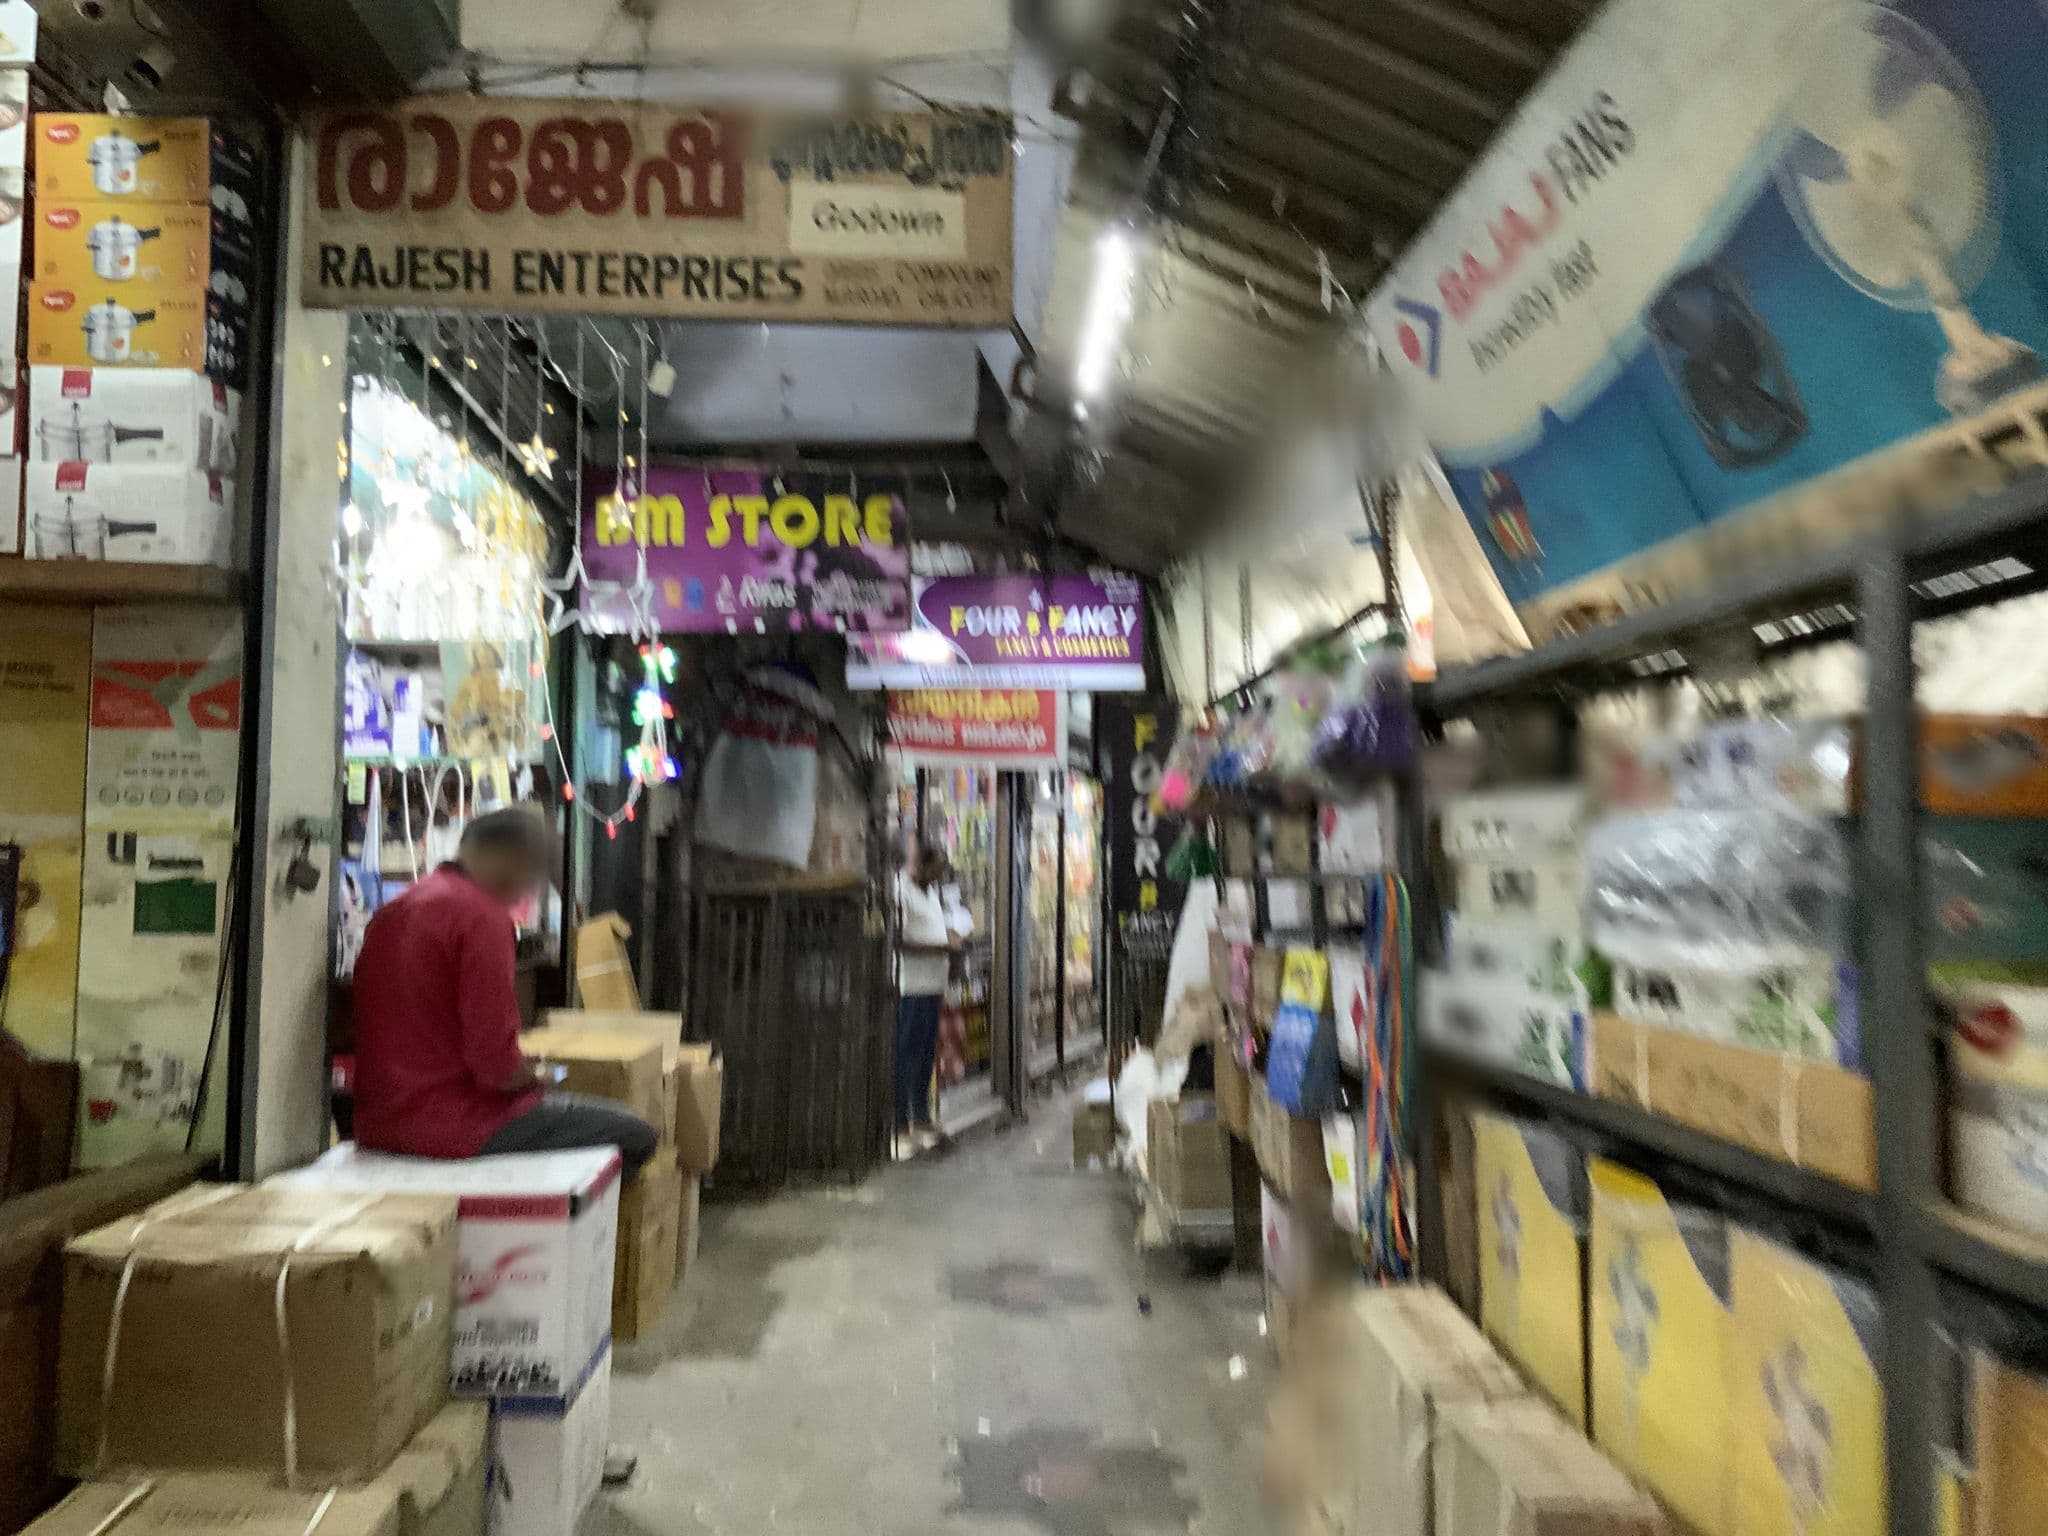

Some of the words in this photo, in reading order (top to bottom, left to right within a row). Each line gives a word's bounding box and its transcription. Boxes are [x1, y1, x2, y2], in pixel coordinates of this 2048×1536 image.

[1436, 171, 1560, 323] BAJAJ
[1546, 90, 1636, 204] FANS
[319, 241, 491, 292] RAJESH
[512, 249, 804, 300] ENTERPRISES
[706, 492, 892, 549] STORE
[950, 605, 1021, 638] FOUR
[1048, 605, 1137, 638] FANCY
